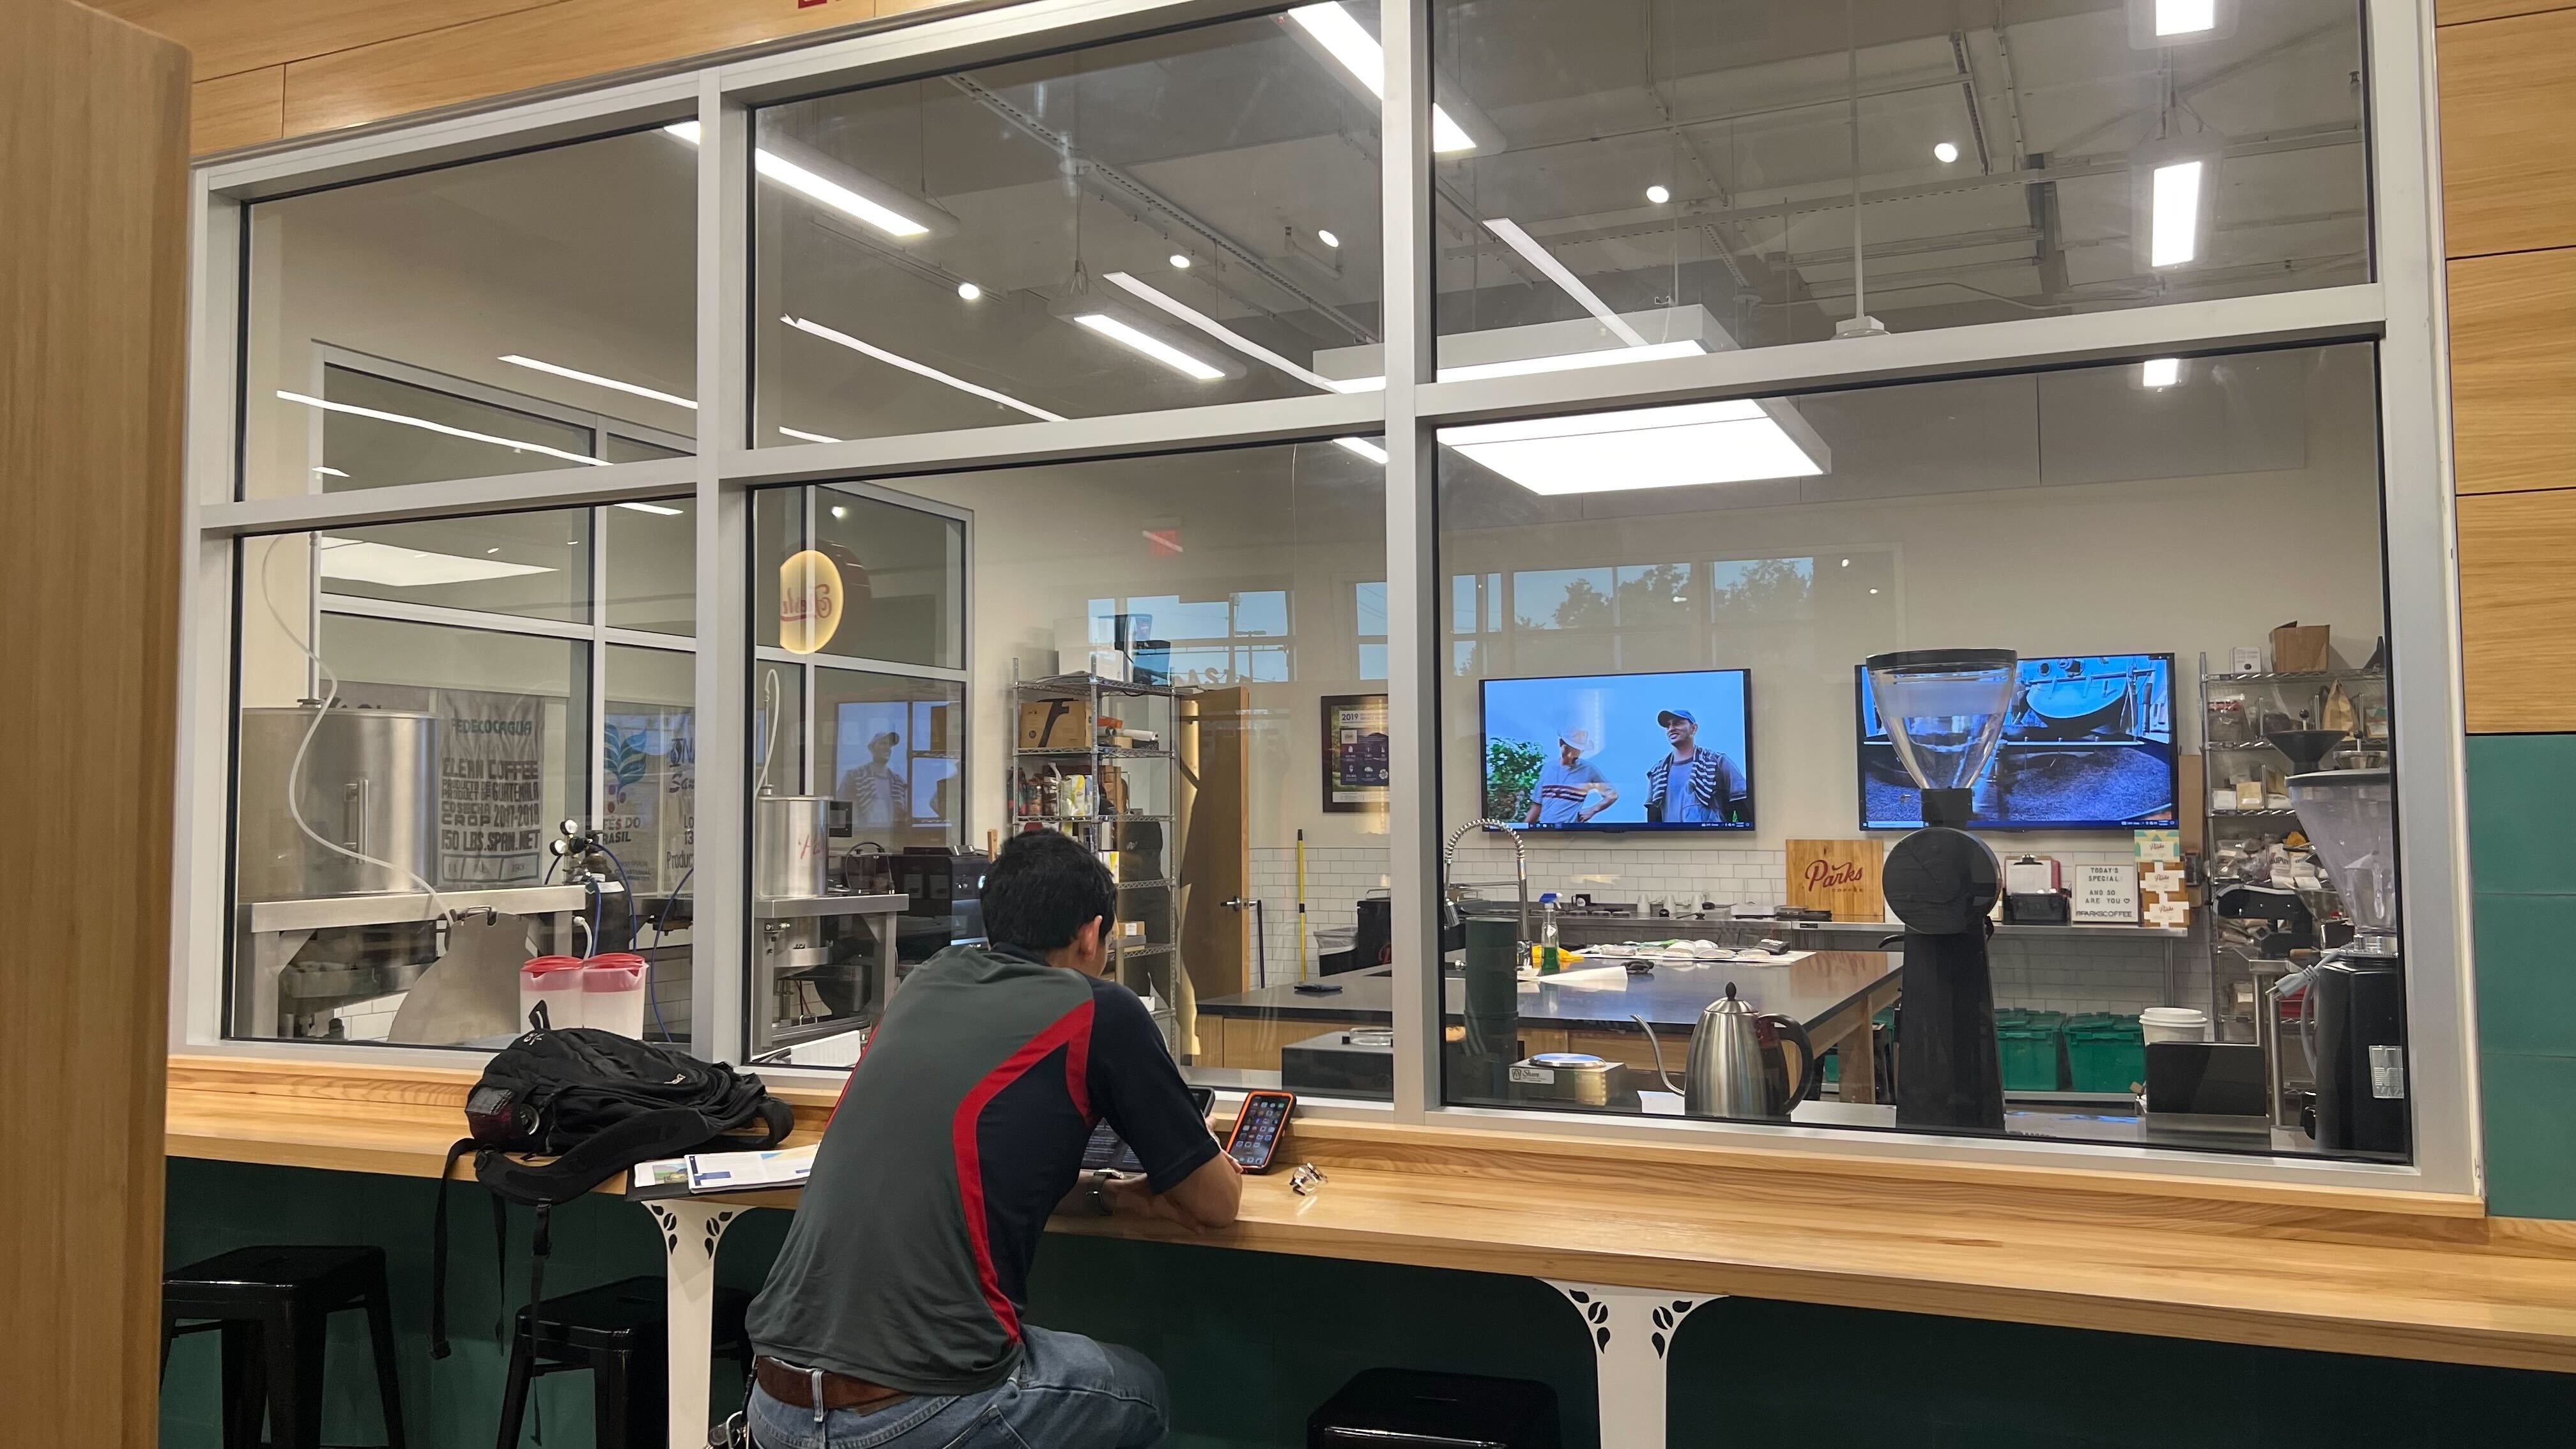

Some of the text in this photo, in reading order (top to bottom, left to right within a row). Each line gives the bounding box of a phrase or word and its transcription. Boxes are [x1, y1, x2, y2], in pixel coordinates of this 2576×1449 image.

[487, 759, 539, 781] COFFEE
[441, 778, 479, 791] PRODUCTO
[441, 789, 479, 801] PRODUCT
[441, 800, 491, 815] COSECHA
[493, 802, 540, 828] 2017-2018
[441, 813, 491, 827] CROP
[625, 817, 641, 829] DO
[441, 829, 459, 850] 150
[1804, 859, 1864, 892] Parks
